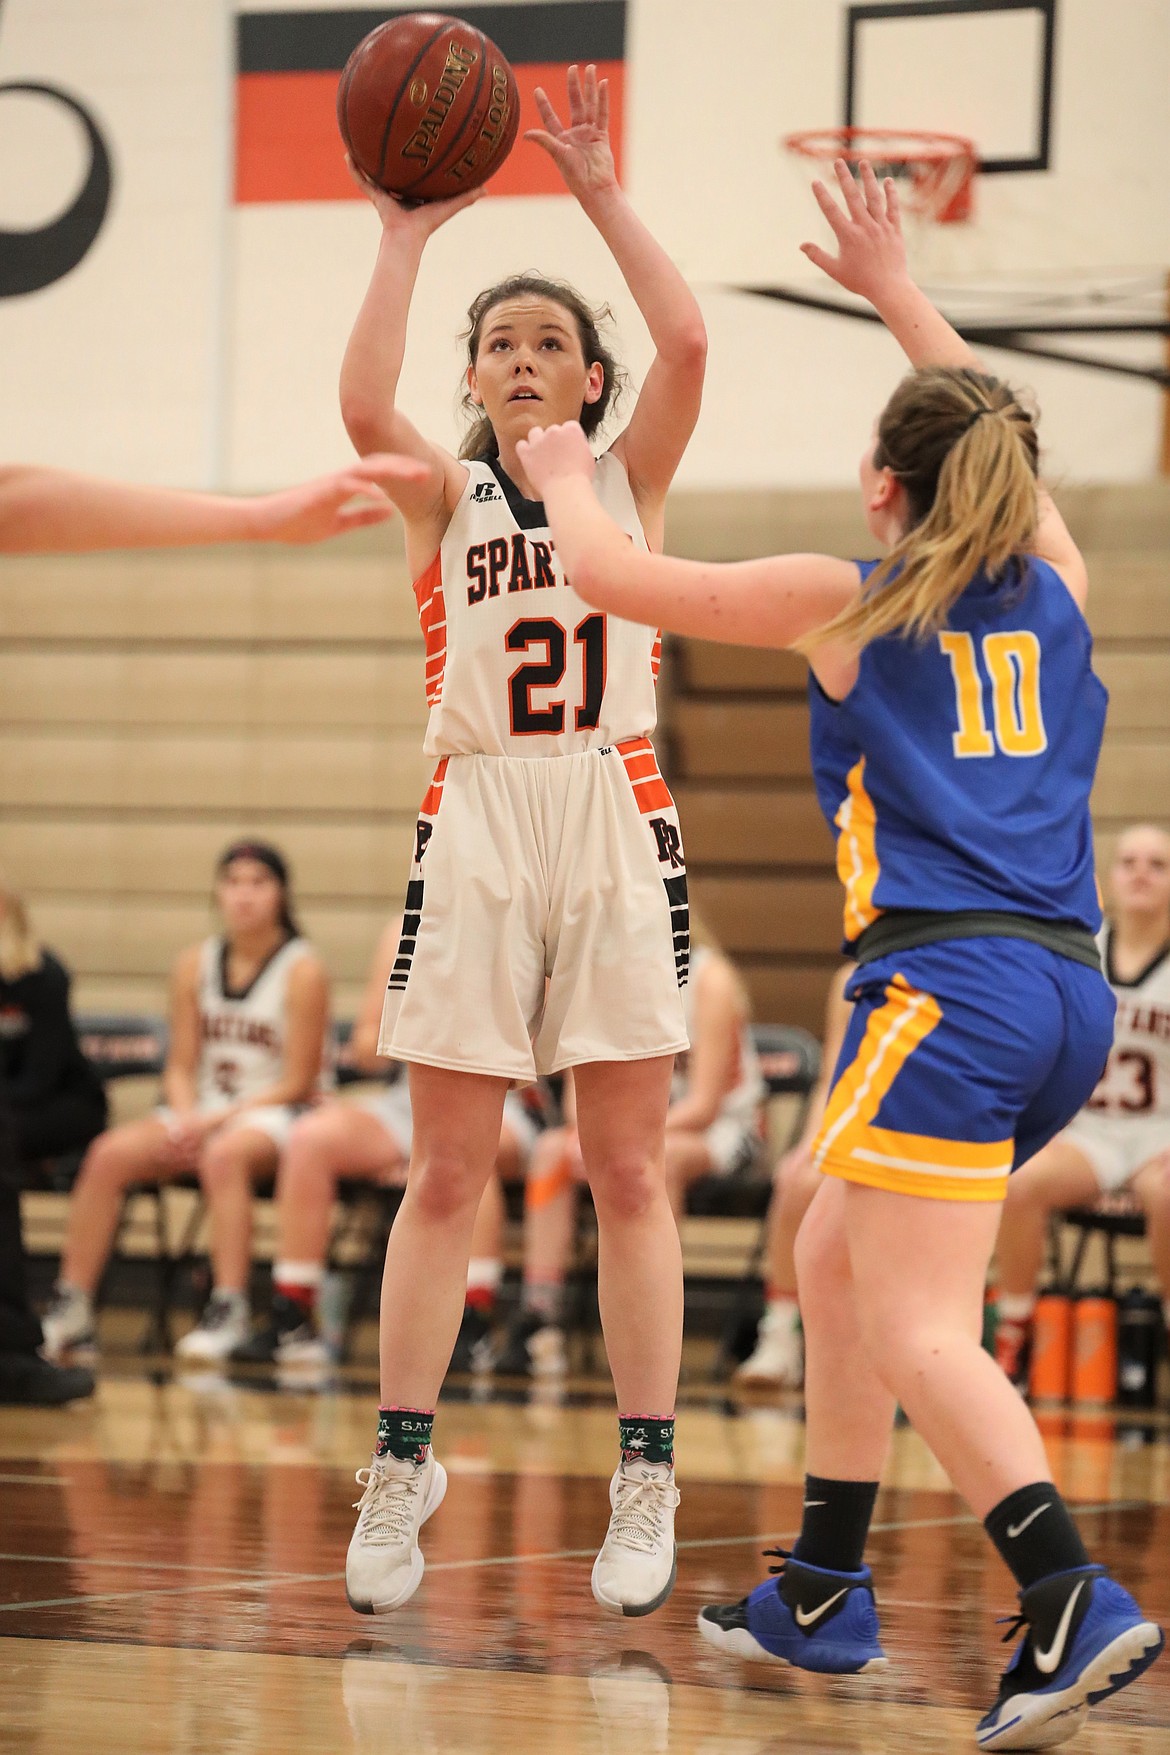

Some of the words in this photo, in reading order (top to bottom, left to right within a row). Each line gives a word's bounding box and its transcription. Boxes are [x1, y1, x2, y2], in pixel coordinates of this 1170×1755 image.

[400, 39, 477, 168] SPALDING
[451, 149, 479, 180] TF
[480, 64, 507, 143] 1000
[466, 532, 573, 606] SPAR
[504, 612, 608, 736] 21
[938, 630, 1048, 758] 10
